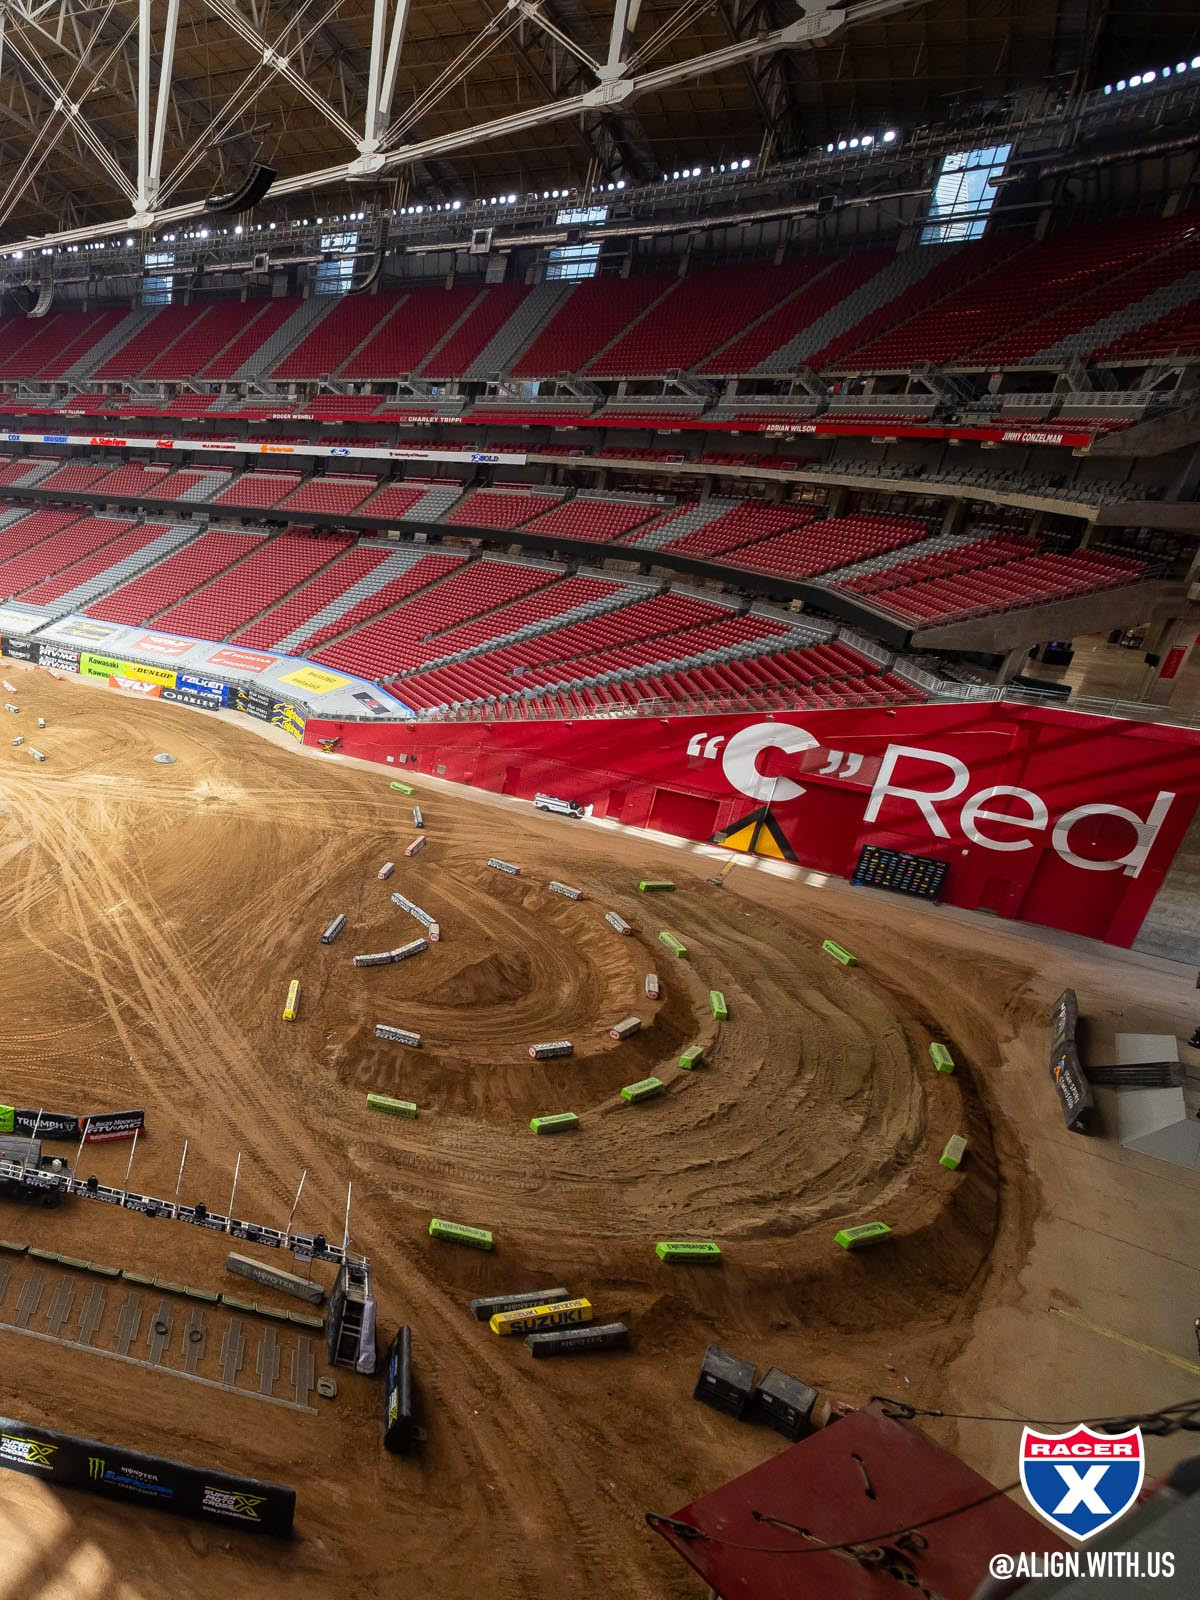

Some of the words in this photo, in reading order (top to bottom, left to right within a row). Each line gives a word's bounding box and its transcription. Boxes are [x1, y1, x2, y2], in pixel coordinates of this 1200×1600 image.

[1002, 432, 1021, 442] JIMMY
[1022, 433, 1063, 444] CONZELMAN
[88, 657, 119, 669] Kawasaki
[232, 652, 271, 664] HONDA
[222, 660, 261, 671] HONDA
[136, 667, 174, 679] DUNLOP
[182, 675, 224, 690] FALKEN
[177, 694, 216, 709] OAKLEY
[863, 743, 1177, 880] Red
[1070, 1084, 1080, 1103] SPORTS
[17, 1117, 64, 1130] TRIUMPH
[440, 1221, 488, 1238] Kawasaki
[666, 1242, 714, 1252] Kawasaki
[254, 1269, 295, 1290] MONSTER
[503, 1301, 545, 1311] MONSTER
[504, 1309, 538, 1321] SUZUKI
[549, 1300, 582, 1313] SUZUKI
[510, 1309, 583, 1334] SUZUKI
[1, 1437, 31, 1449] SUPER
[2, 1442, 29, 1454] MOTO
[0, 1447, 29, 1458] CROSS
[0, 1453, 17, 1461] WORLD
[121, 1466, 159, 1481] MONSTER
[104, 1471, 174, 1495] SUPERCROSS
[204, 1489, 236, 1501] SUPER
[205, 1494, 235, 1505] MOTO
[202, 1499, 234, 1511] CROSS
[202, 1506, 221, 1514] WORLD
